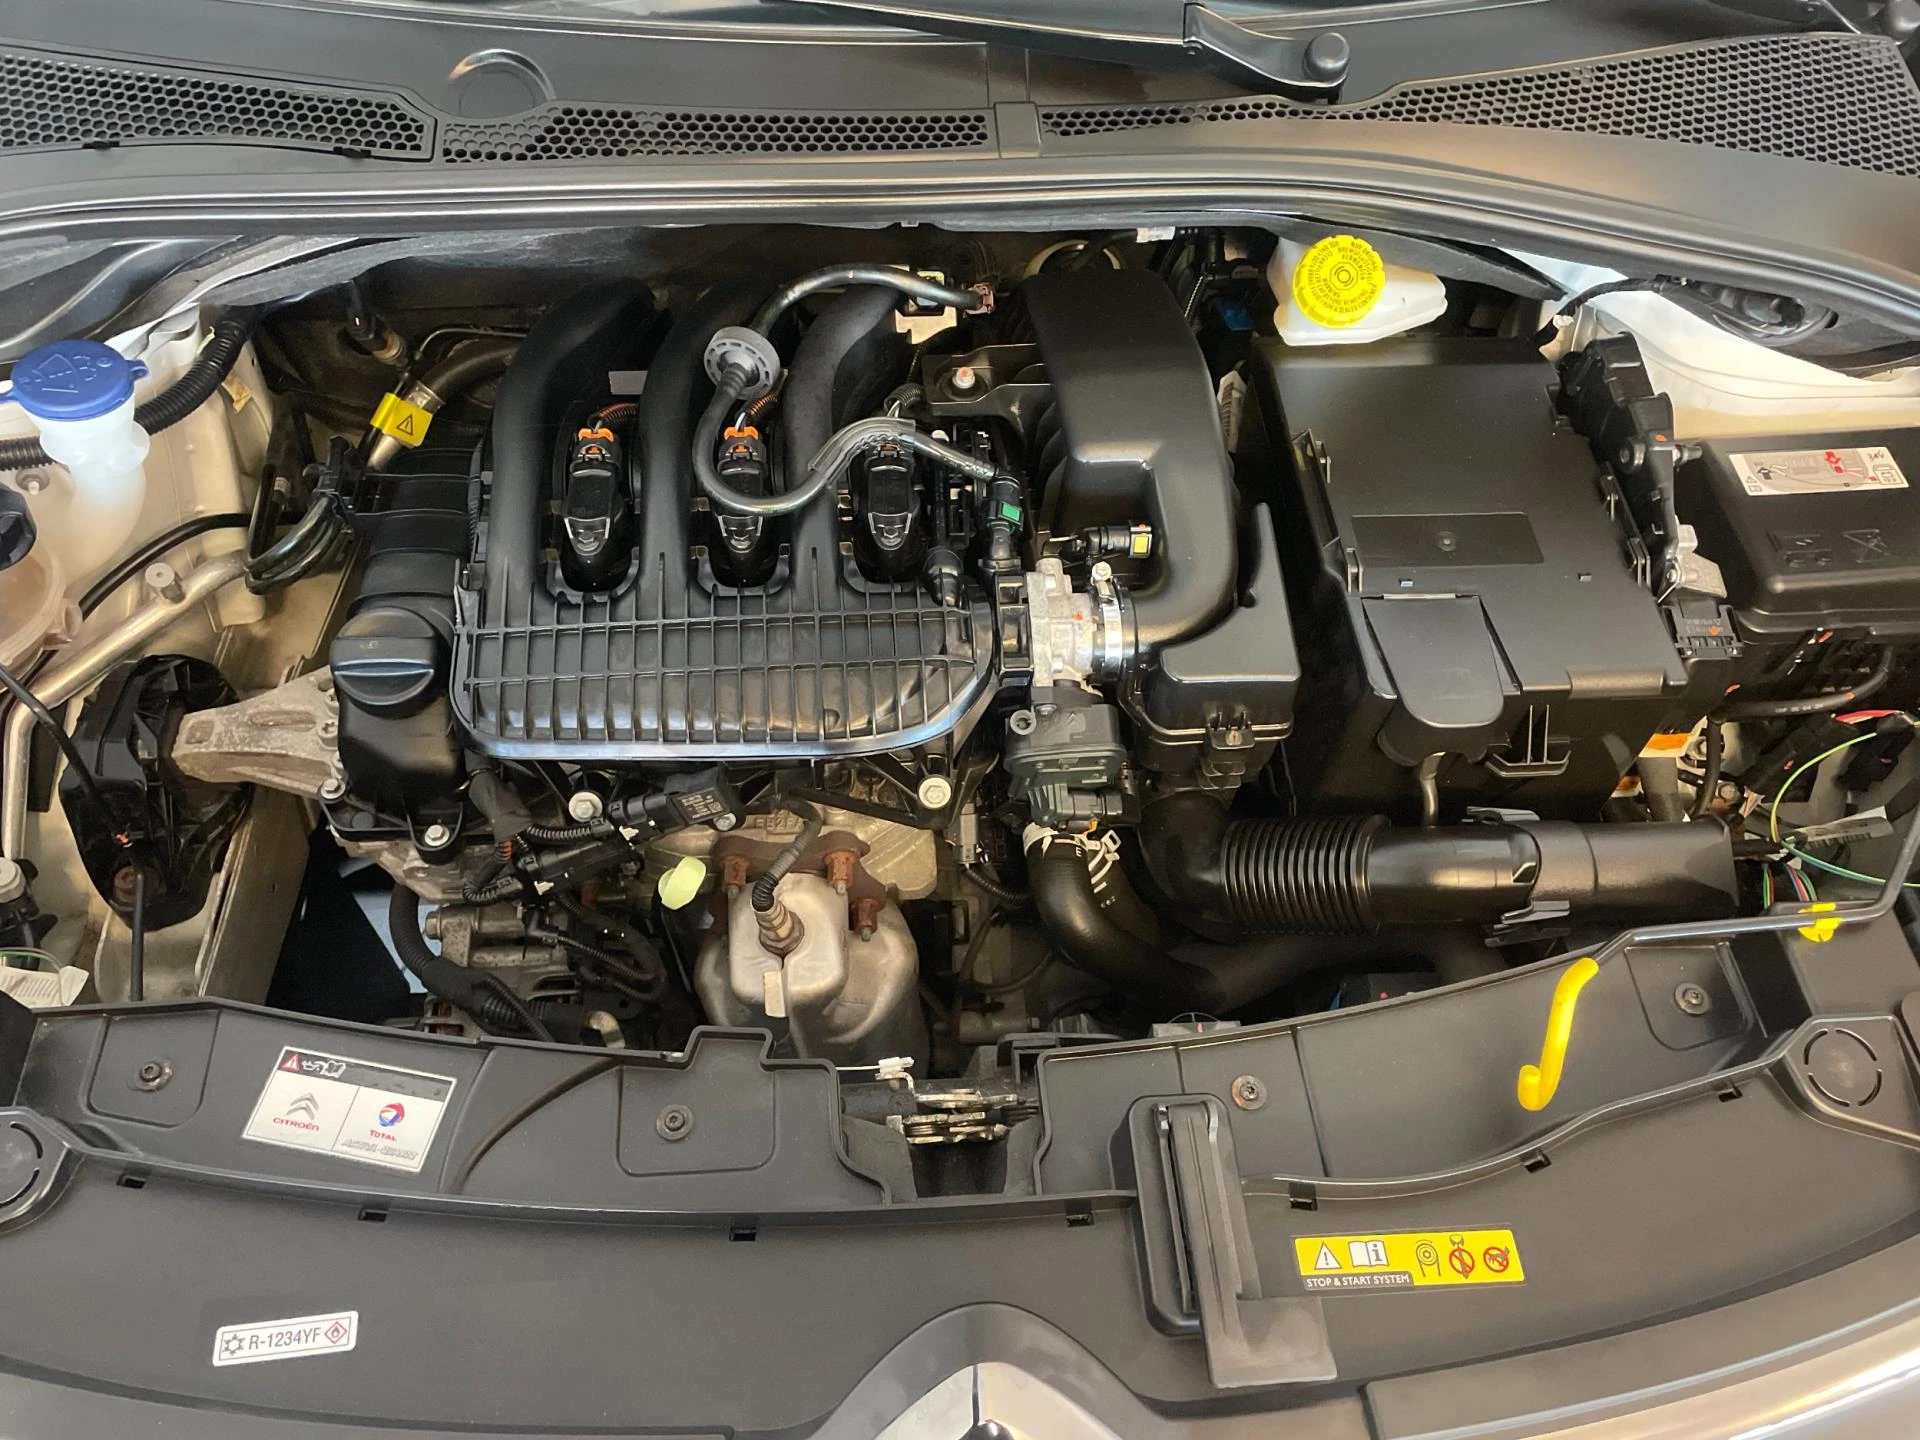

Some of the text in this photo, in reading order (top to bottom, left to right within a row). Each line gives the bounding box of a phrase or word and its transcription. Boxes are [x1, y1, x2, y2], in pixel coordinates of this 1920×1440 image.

[369, 1129, 397, 1142] TOTAL
[1306, 1274, 1410, 1287] STOP & START SYSTEM
[248, 1327, 322, 1350] R-1234YF
